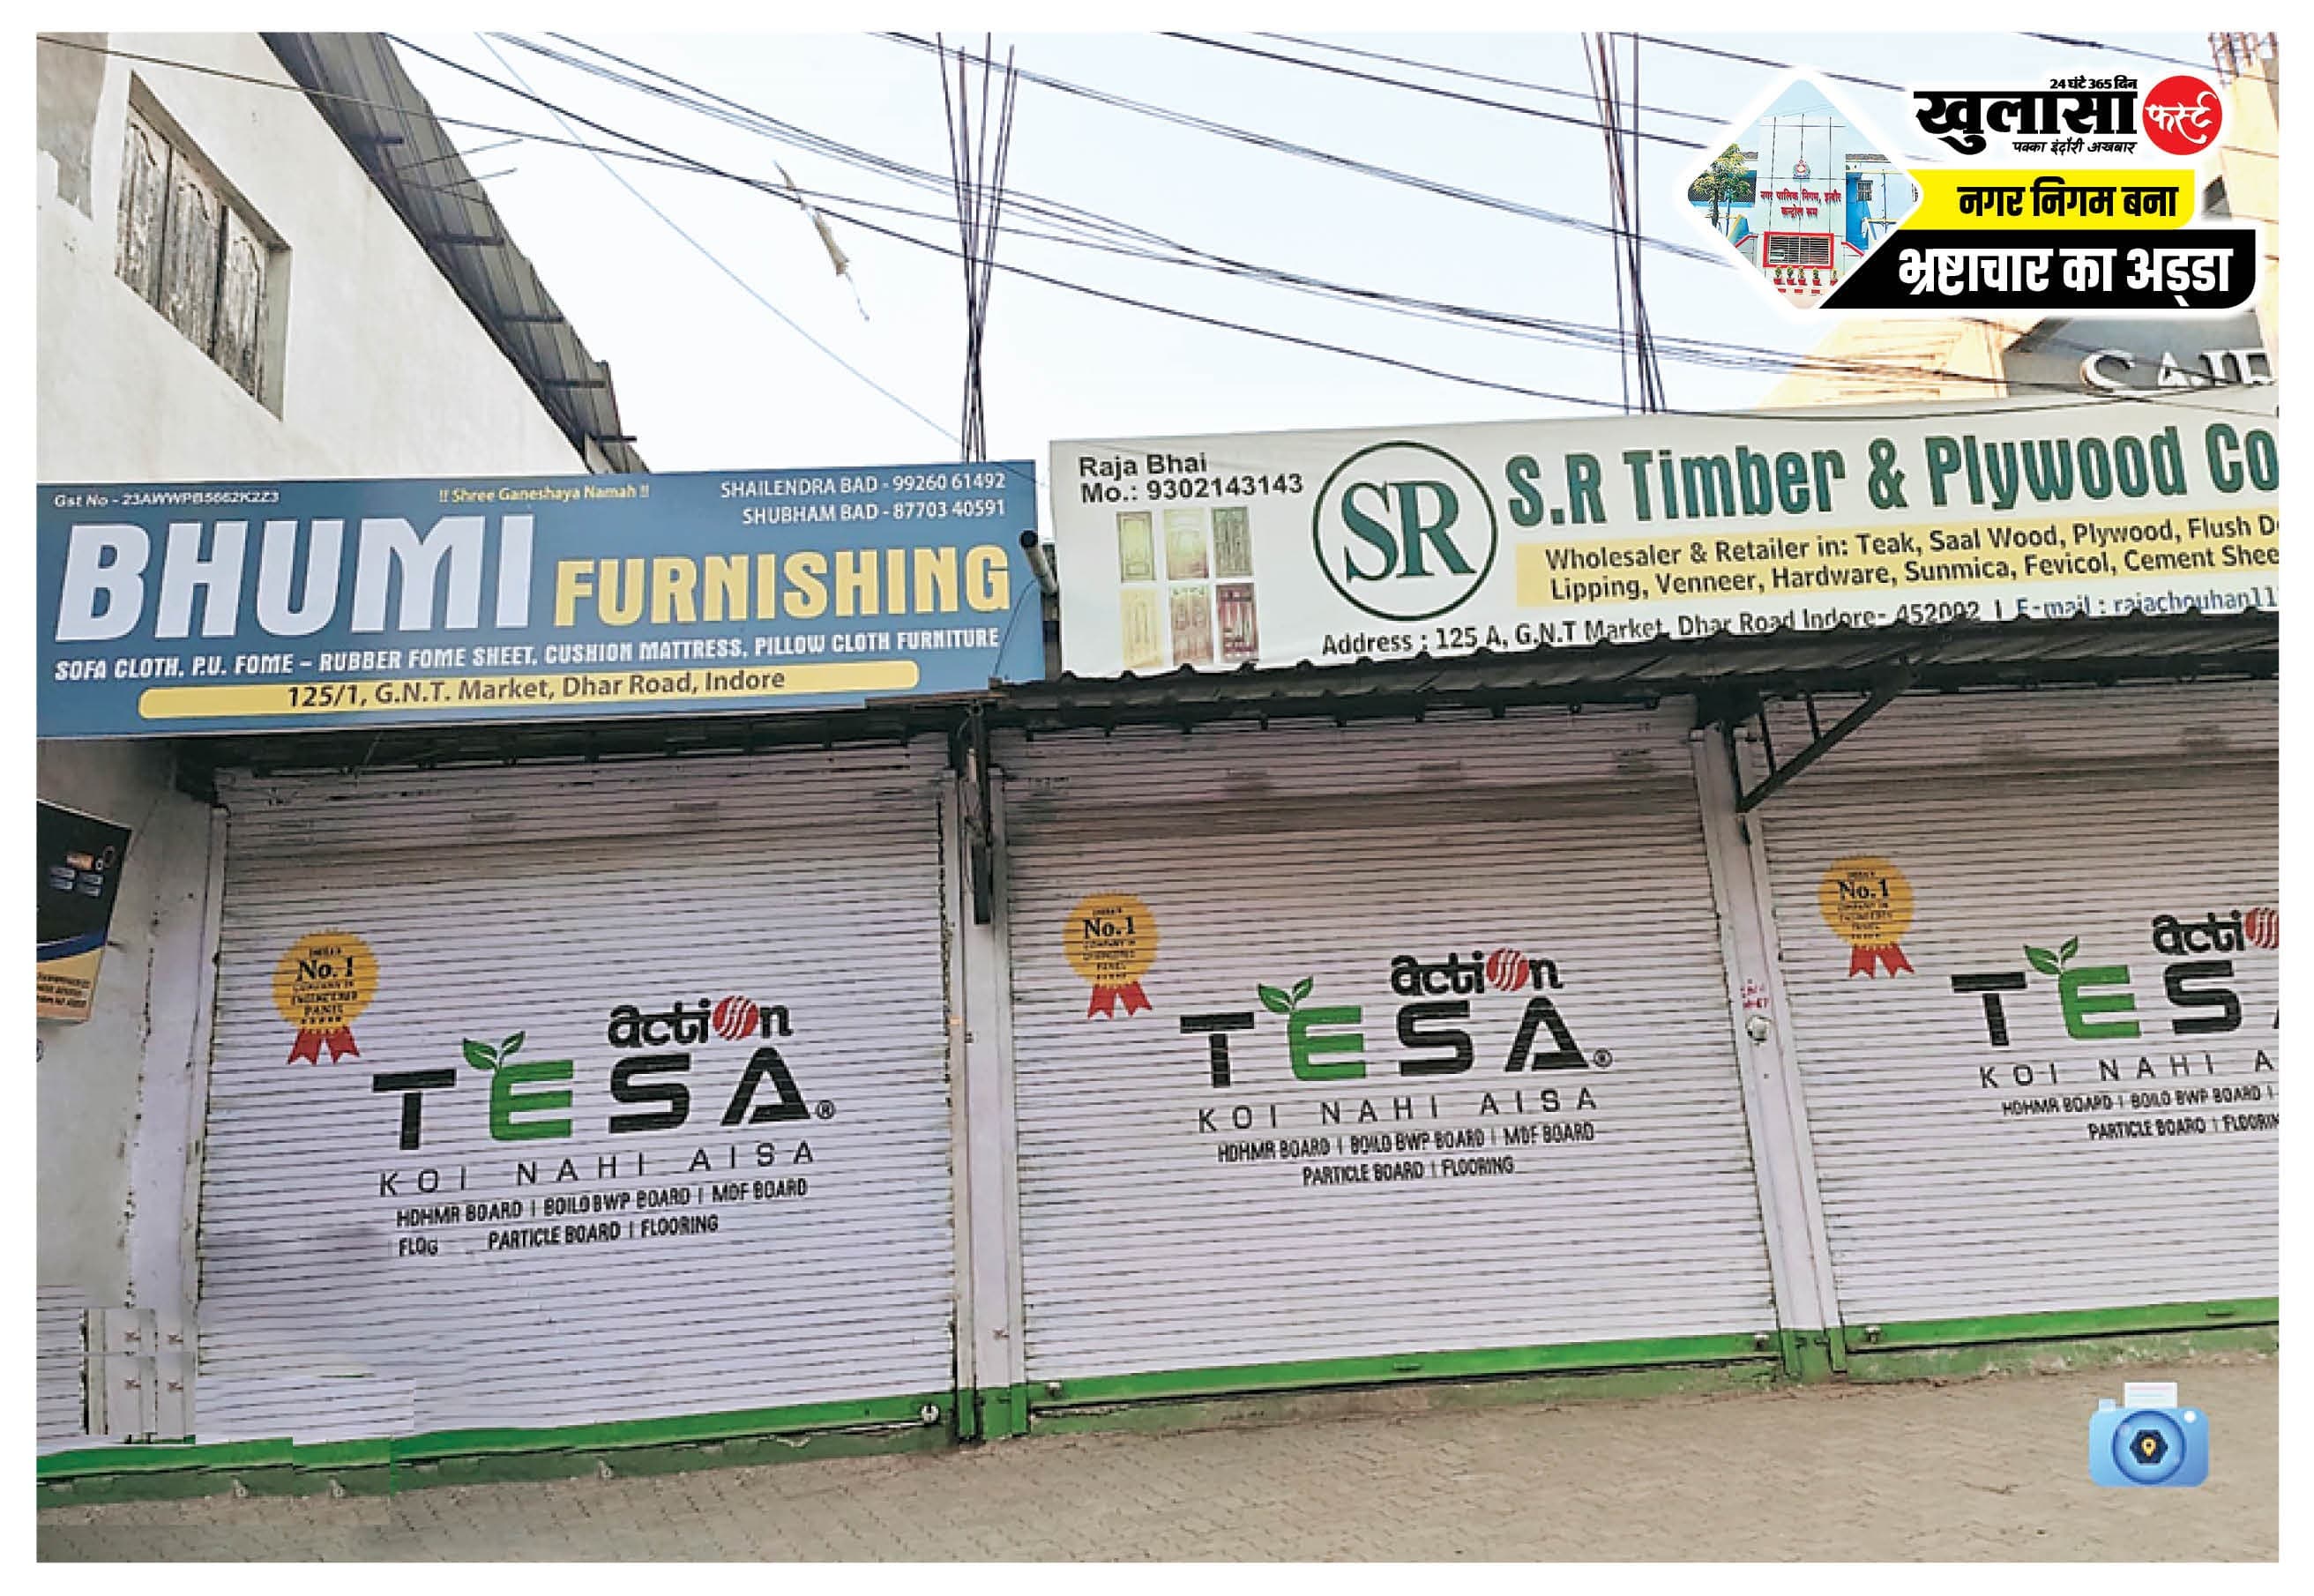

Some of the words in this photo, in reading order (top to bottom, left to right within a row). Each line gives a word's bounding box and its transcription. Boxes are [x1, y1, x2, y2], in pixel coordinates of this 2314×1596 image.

[721, 477, 837, 498] SHAILENDRA
[840, 476, 878, 495] BAD
[892, 474, 948, 493] 99260
[952, 473, 1006, 490] 61492
[1079, 456, 1138, 481] Raja
[1147, 452, 1207, 475] Bhai
[1146, 474, 1304, 499] 9302143143
[1505, 452, 1607, 527] S.R
[1623, 444, 1846, 522] Timber
[1869, 437, 1908, 510] &
[1924, 426, 2188, 511] Plywood
[55, 494, 81, 507] Gst
[86, 494, 108, 507] No
[452, 488, 495, 502] Shree
[499, 486, 580, 503] Ganeshaya
[584, 484, 636, 499] Namah
[743, 505, 837, 525] SHUBHAM
[840, 503, 879, 521] BAD
[892, 502, 947, 519] 87703
[952, 499, 1005, 517] 40591
[1341, 480, 1477, 584] SR
[1546, 544, 1682, 571] Wholesaler
[1691, 543, 1708, 563] &
[1715, 536, 1810, 563] Retailer
[1817, 535, 1848, 557] in:
[1855, 531, 1922, 556] Teak,
[1930, 527, 1982, 553] Saal
[1989, 524, 2066, 550] Wood,
[2072, 518, 2181, 548] Plywood,
[2188, 515, 2251, 540] Flush
[2258, 514, 2279, 536] D
[55, 515, 534, 641] BHUMI
[555, 544, 1011, 627] FURNISHING
[1551, 577, 1649, 602] Lipping,
[1655, 571, 1764, 595] Venneer,
[1772, 564, 1897, 589] Hardware,
[1904, 556, 2017, 584] Sunmica,
[2024, 551, 2116, 578] Fevicol,
[2124, 545, 2215, 571] Cement
[1323, 632, 1411, 655] Address
[1436, 627, 1478, 651] 125
[1677, 615, 1732, 636] Dhar
[1740, 608, 1794, 633] Road
[2113, 585, 2279, 613] rajachouhan11
[55, 660, 107, 682] SOFA
[235, 653, 294, 675] FOME
[318, 650, 401, 672] RUBBER
[408, 648, 466, 669] FOME
[546, 642, 633, 666] CUSHION
[755, 635, 825, 656] PILLOW
[832, 631, 891, 653] CLOTH
[897, 627, 999, 650] FURNITURE
[288, 685, 368, 709] 125/1,
[375, 682, 452, 704] G.N.T.
[458, 678, 555, 702] Market,
[563, 675, 622, 698] Dhar
[630, 673, 699, 697] Road,
[705, 669, 786, 691] Indore
[1951, 960, 2279, 1048] TES
[1180, 996, 1590, 1089] TESA
[1980, 1062, 2058, 1090] KOI
[2099, 1053, 2213, 1082] NAHI
[372, 1047, 812, 1151] TESA
[1198, 1104, 1277, 1133] KOI
[1322, 1094, 1438, 1124] NAHI
[1480, 1086, 1597, 1115] AISA
[2063, 1094, 2113, 1114] BOARD
[2213, 1085, 2261, 1103] BOARD
[1218, 1141, 1276, 1163] HDHMR
[1280, 1137, 1331, 1159] BOARD
[1435, 1128, 1485, 1148] BOARD
[1542, 1121, 1594, 1143] BOARD
[2087, 1120, 2154, 1141] PARTICLE
[2155, 1115, 2206, 1137] BOARD
[2222, 1113, 2279, 1131] FLOORIN
[379, 1165, 467, 1198] KOI
[517, 1152, 644, 1186] NAHI
[688, 1141, 814, 1173] AISA
[1302, 1163, 1370, 1186] PARTICLE
[1373, 1160, 1423, 1182] BOARD
[1441, 1155, 1516, 1177] FLOORING
[396, 1204, 459, 1227] HDHMR
[466, 1200, 523, 1222] BOARD
[637, 1187, 690, 1209] BOARD
[753, 1177, 809, 1199] BOARD
[489, 1225, 562, 1249] PARTICLE
[565, 1220, 621, 1244] BOARD
[641, 1213, 719, 1239] FLOORING
